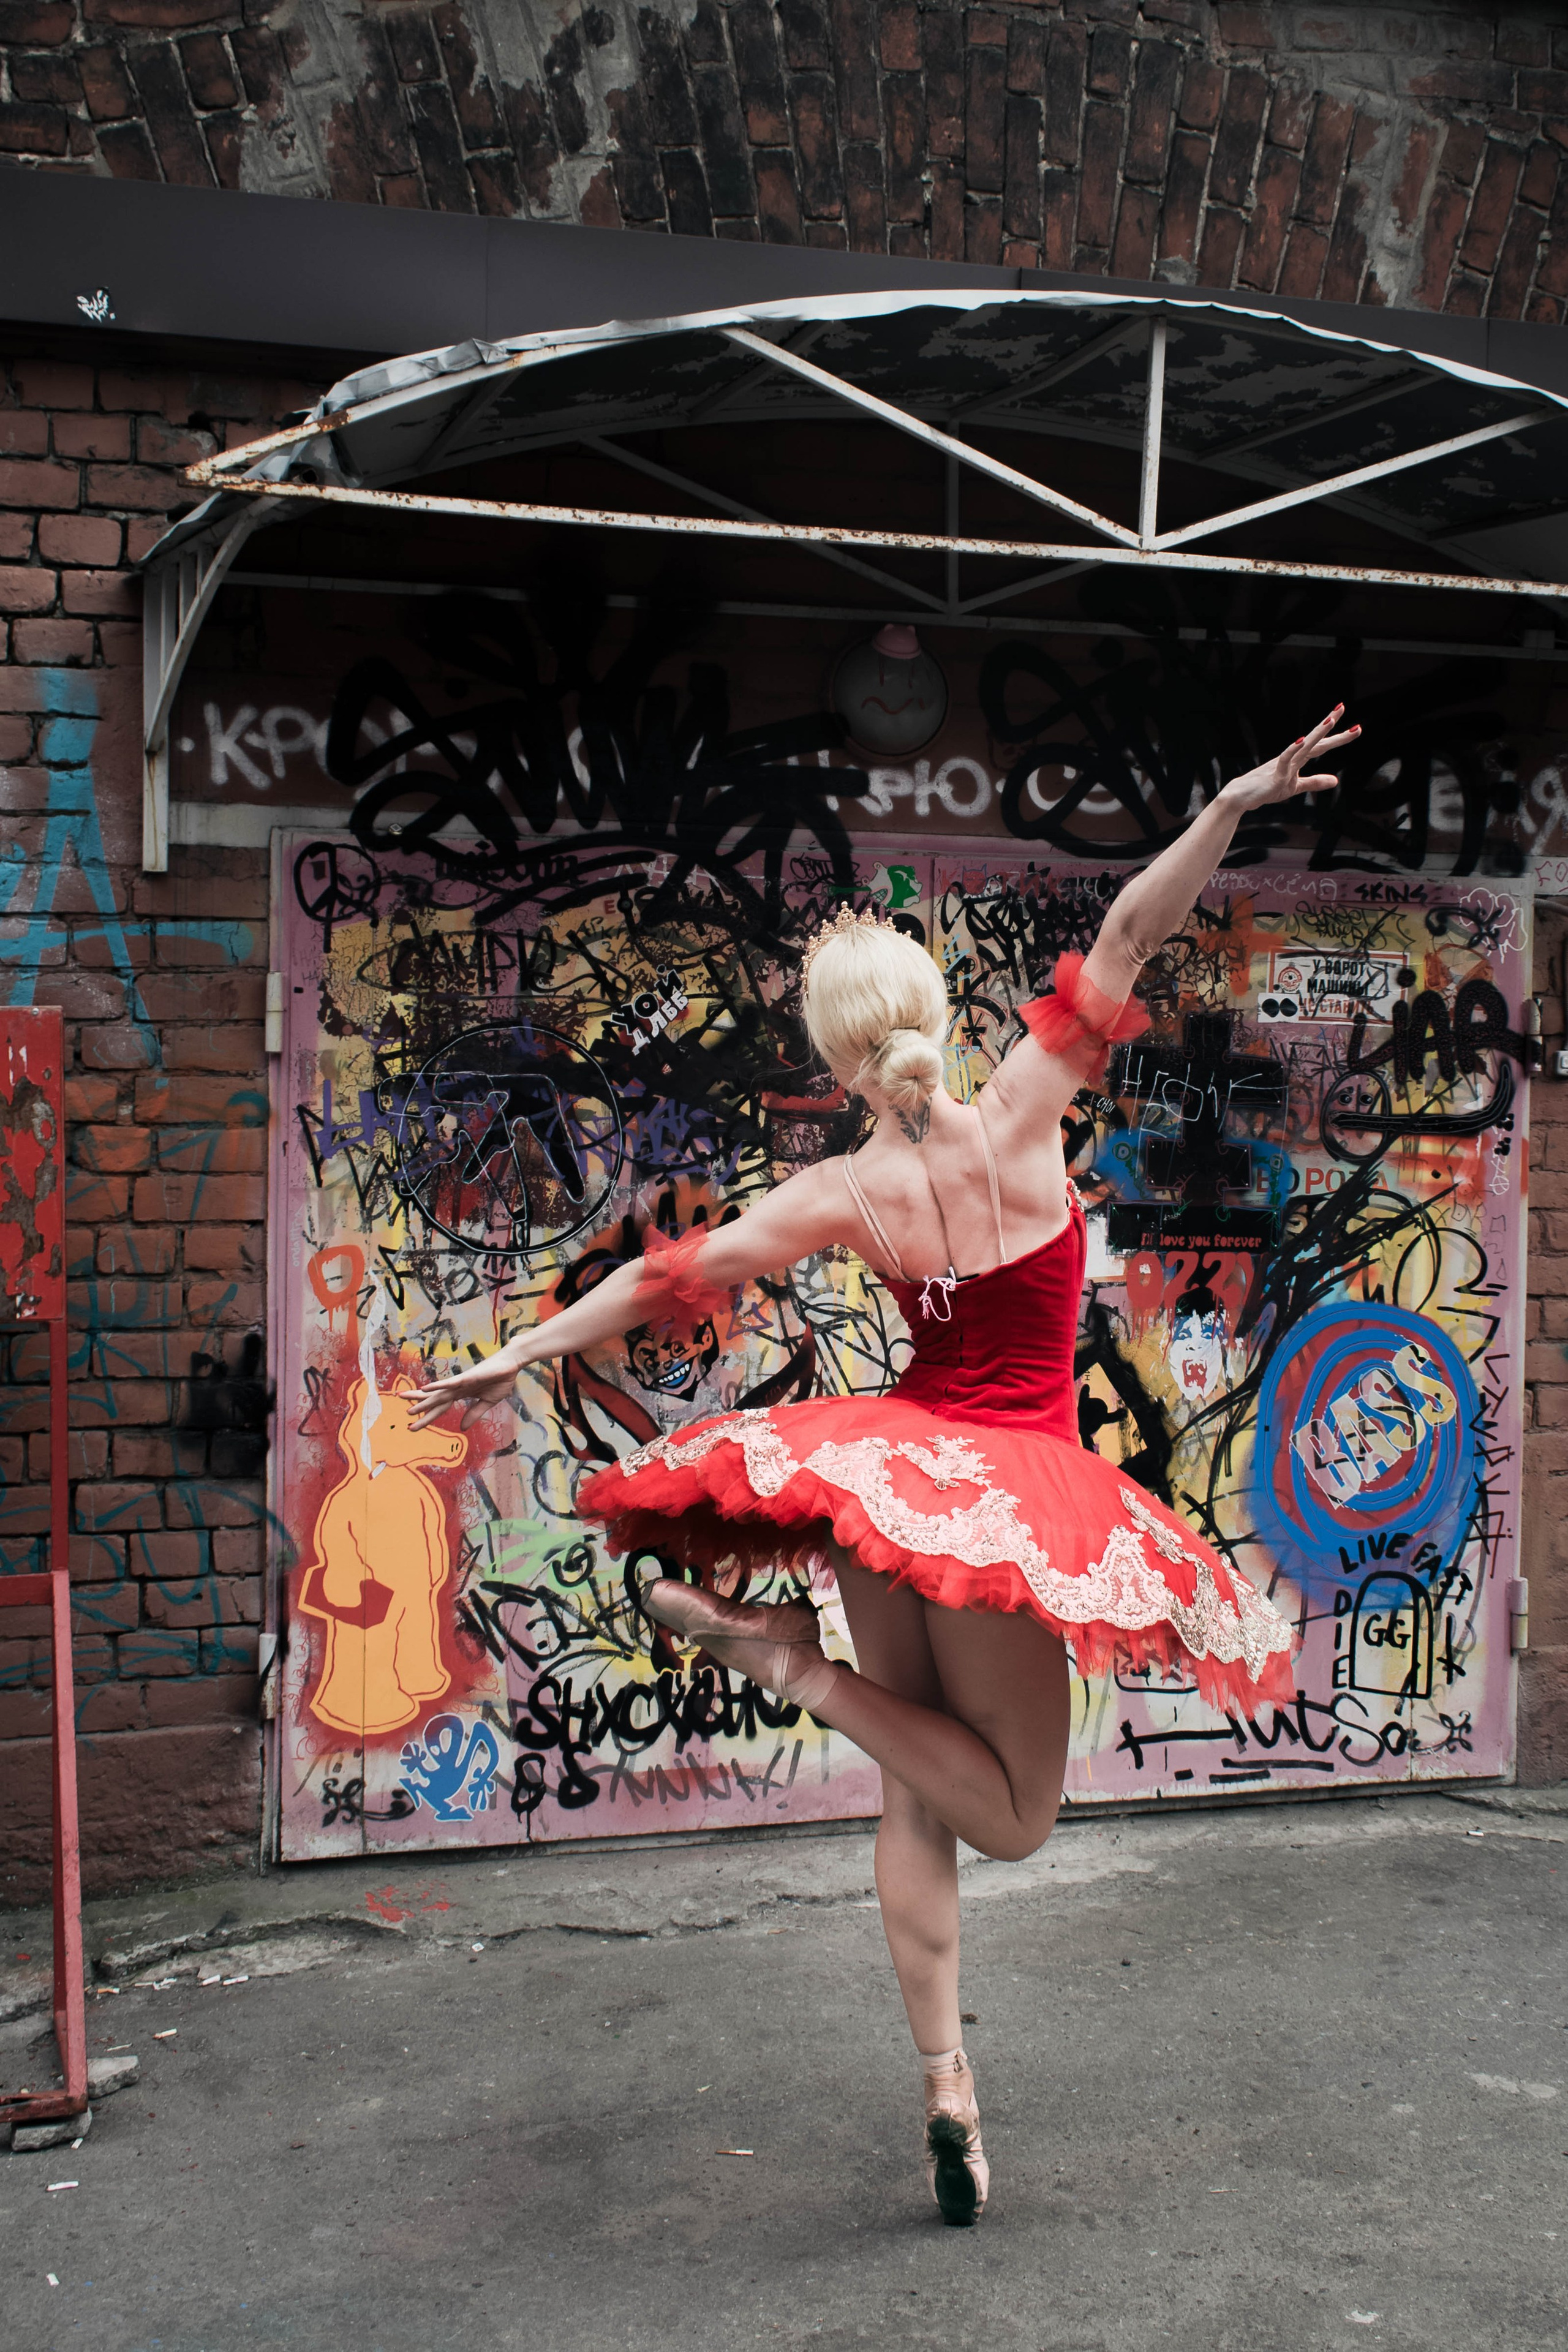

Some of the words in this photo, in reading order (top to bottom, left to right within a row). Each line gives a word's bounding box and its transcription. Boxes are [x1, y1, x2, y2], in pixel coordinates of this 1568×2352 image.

[1354, 881, 1428, 903] SKINS
[1313, 959, 1321, 973] У
[1325, 960, 1366, 976] ВОРОТ
[1307, 978, 1369, 995] МАШИНЫ
[1159, 1232, 1185, 1246] love
[1188, 1235, 1211, 1250] you
[1213, 1234, 1262, 1248] forever
[1289, 1341, 1457, 1510] BASS
[1338, 1532, 1411, 1574] LIVE
[1332, 1589, 1352, 1689] DIE
[1363, 1613, 1411, 1649] GG
